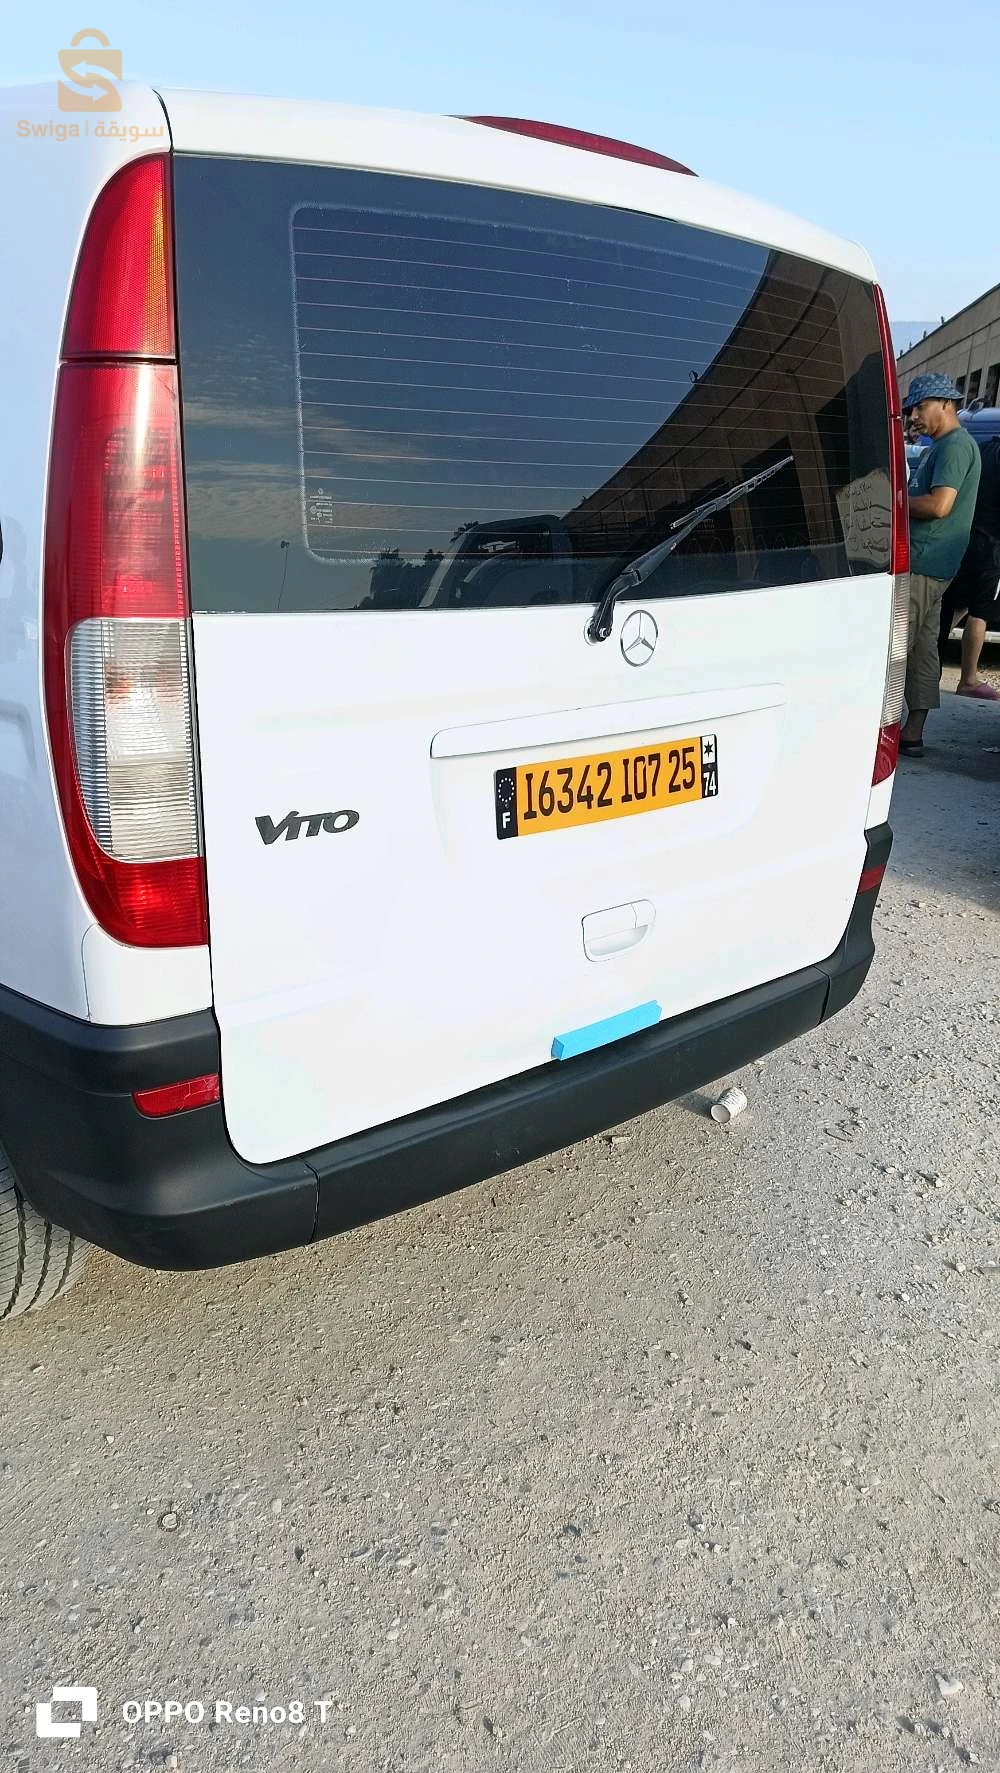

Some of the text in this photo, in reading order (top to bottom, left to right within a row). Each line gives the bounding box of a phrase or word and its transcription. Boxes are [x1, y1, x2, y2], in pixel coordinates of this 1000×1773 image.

[523, 746, 696, 821] 16342 107 25
[703, 769, 717, 798] 74
[501, 811, 511, 829] F
